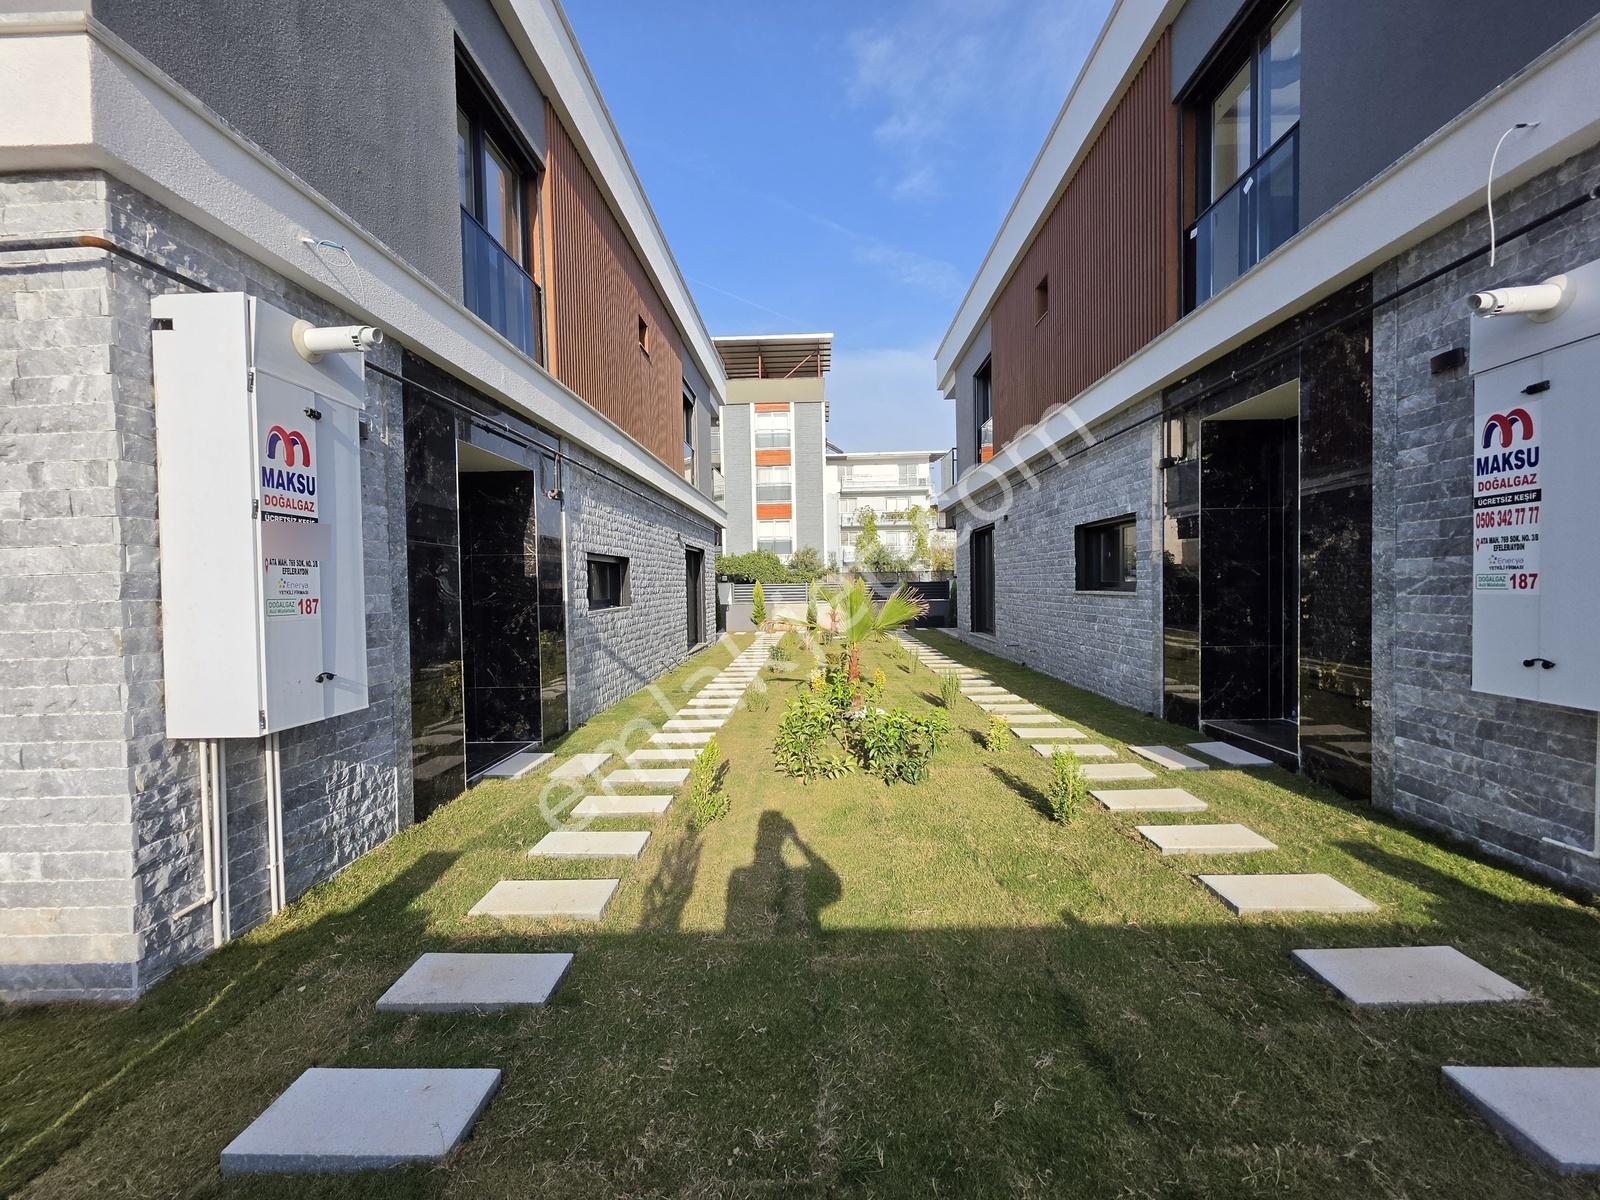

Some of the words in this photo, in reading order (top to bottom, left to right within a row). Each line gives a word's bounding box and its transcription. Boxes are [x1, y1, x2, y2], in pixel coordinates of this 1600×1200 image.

[1476, 446, 1540, 477] MAKSU
[261, 466, 316, 496] MAKSU
[1478, 473, 1537, 493] DOĞALGAZ
[264, 494, 315, 513] DOĞALGAZ
[1514, 492, 1537, 503] KEŞİF
[1475, 511, 1495, 529] 0506
[1497, 509, 1513, 527] 342
[1515, 507, 1526, 525] 77
[1528, 506, 1540, 524] 77
[1509, 573, 1538, 589] 187
[297, 598, 319, 615] 187
